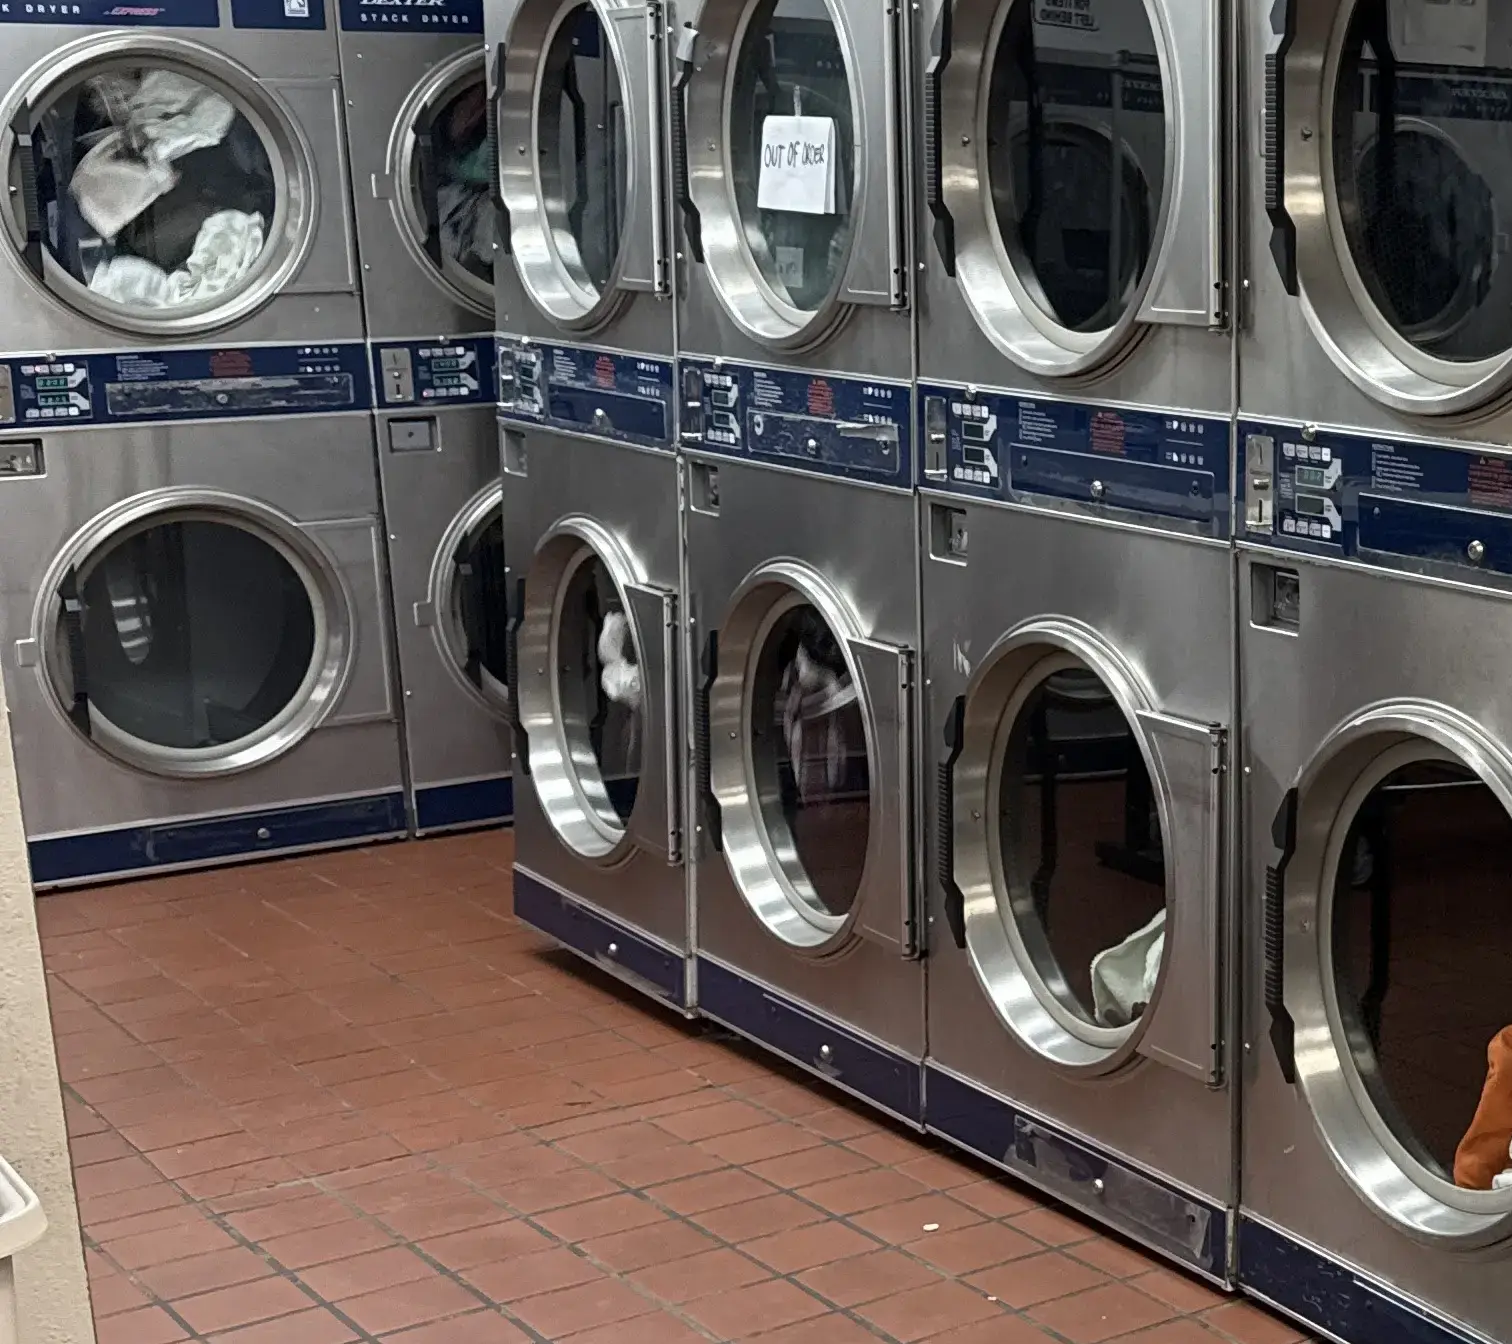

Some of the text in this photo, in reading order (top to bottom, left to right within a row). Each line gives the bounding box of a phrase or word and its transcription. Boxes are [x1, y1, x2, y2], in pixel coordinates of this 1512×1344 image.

[25, 4, 80, 14] DRYER
[360, 13, 469, 23] STACK DRYER
[764, 140, 825, 168] OUT OF ORDER
